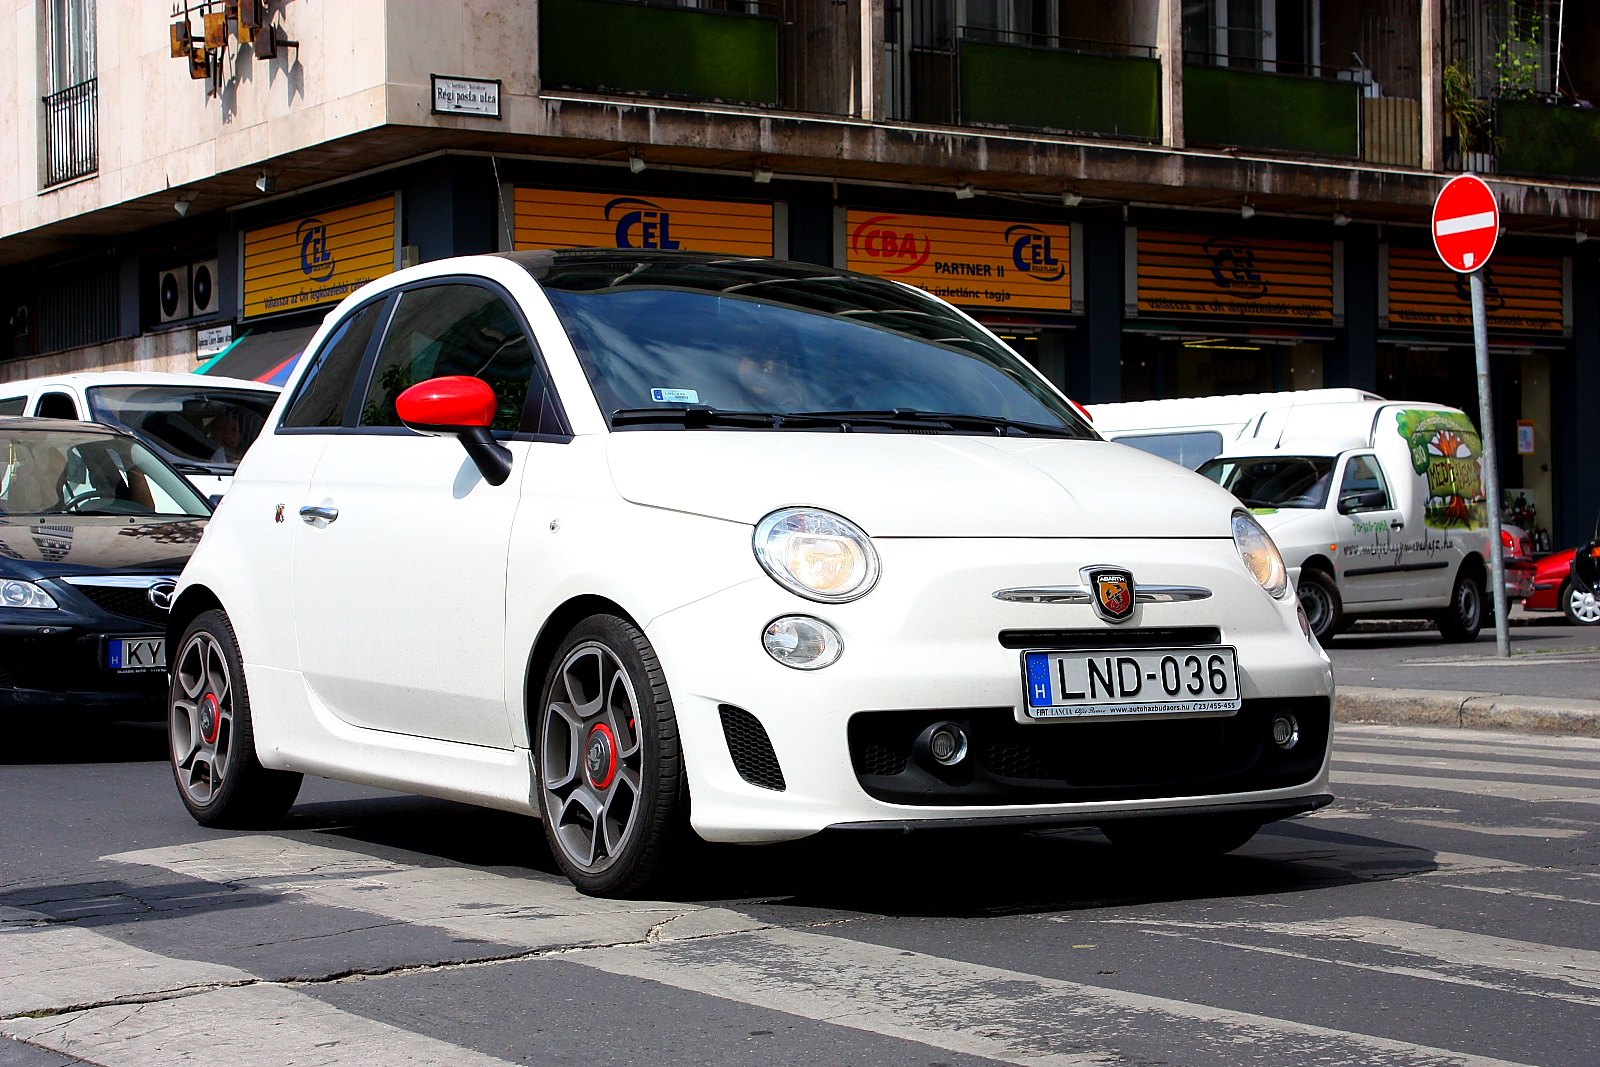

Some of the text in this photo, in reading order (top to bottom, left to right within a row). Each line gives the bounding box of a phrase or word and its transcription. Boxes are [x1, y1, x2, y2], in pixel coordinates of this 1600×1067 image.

[437, 87, 454, 103] Régi
[456, 90, 477, 104] posta
[864, 230, 918, 259] CBA
[934, 261, 992, 277] PARTNER
[264, 295, 289, 309] Válassza
[935, 286, 980, 299] üzletlánc
[985, 290, 1011, 302] tagja
[1148, 297, 1191, 311] Válassza
[1196, 303, 1207, 311] az
[112, 656, 119, 664] H
[128, 641, 165, 664] KY
[1057, 654, 1228, 700] LND-036
[1034, 684, 1046, 699] H
[1036, 708, 1049, 716] FIAT
[1051, 708, 1073, 716] LANCIA
[1110, 704, 1190, 713] www.autohazbudaors.hu
[1198, 702, 1236, 711] 23/455-455
